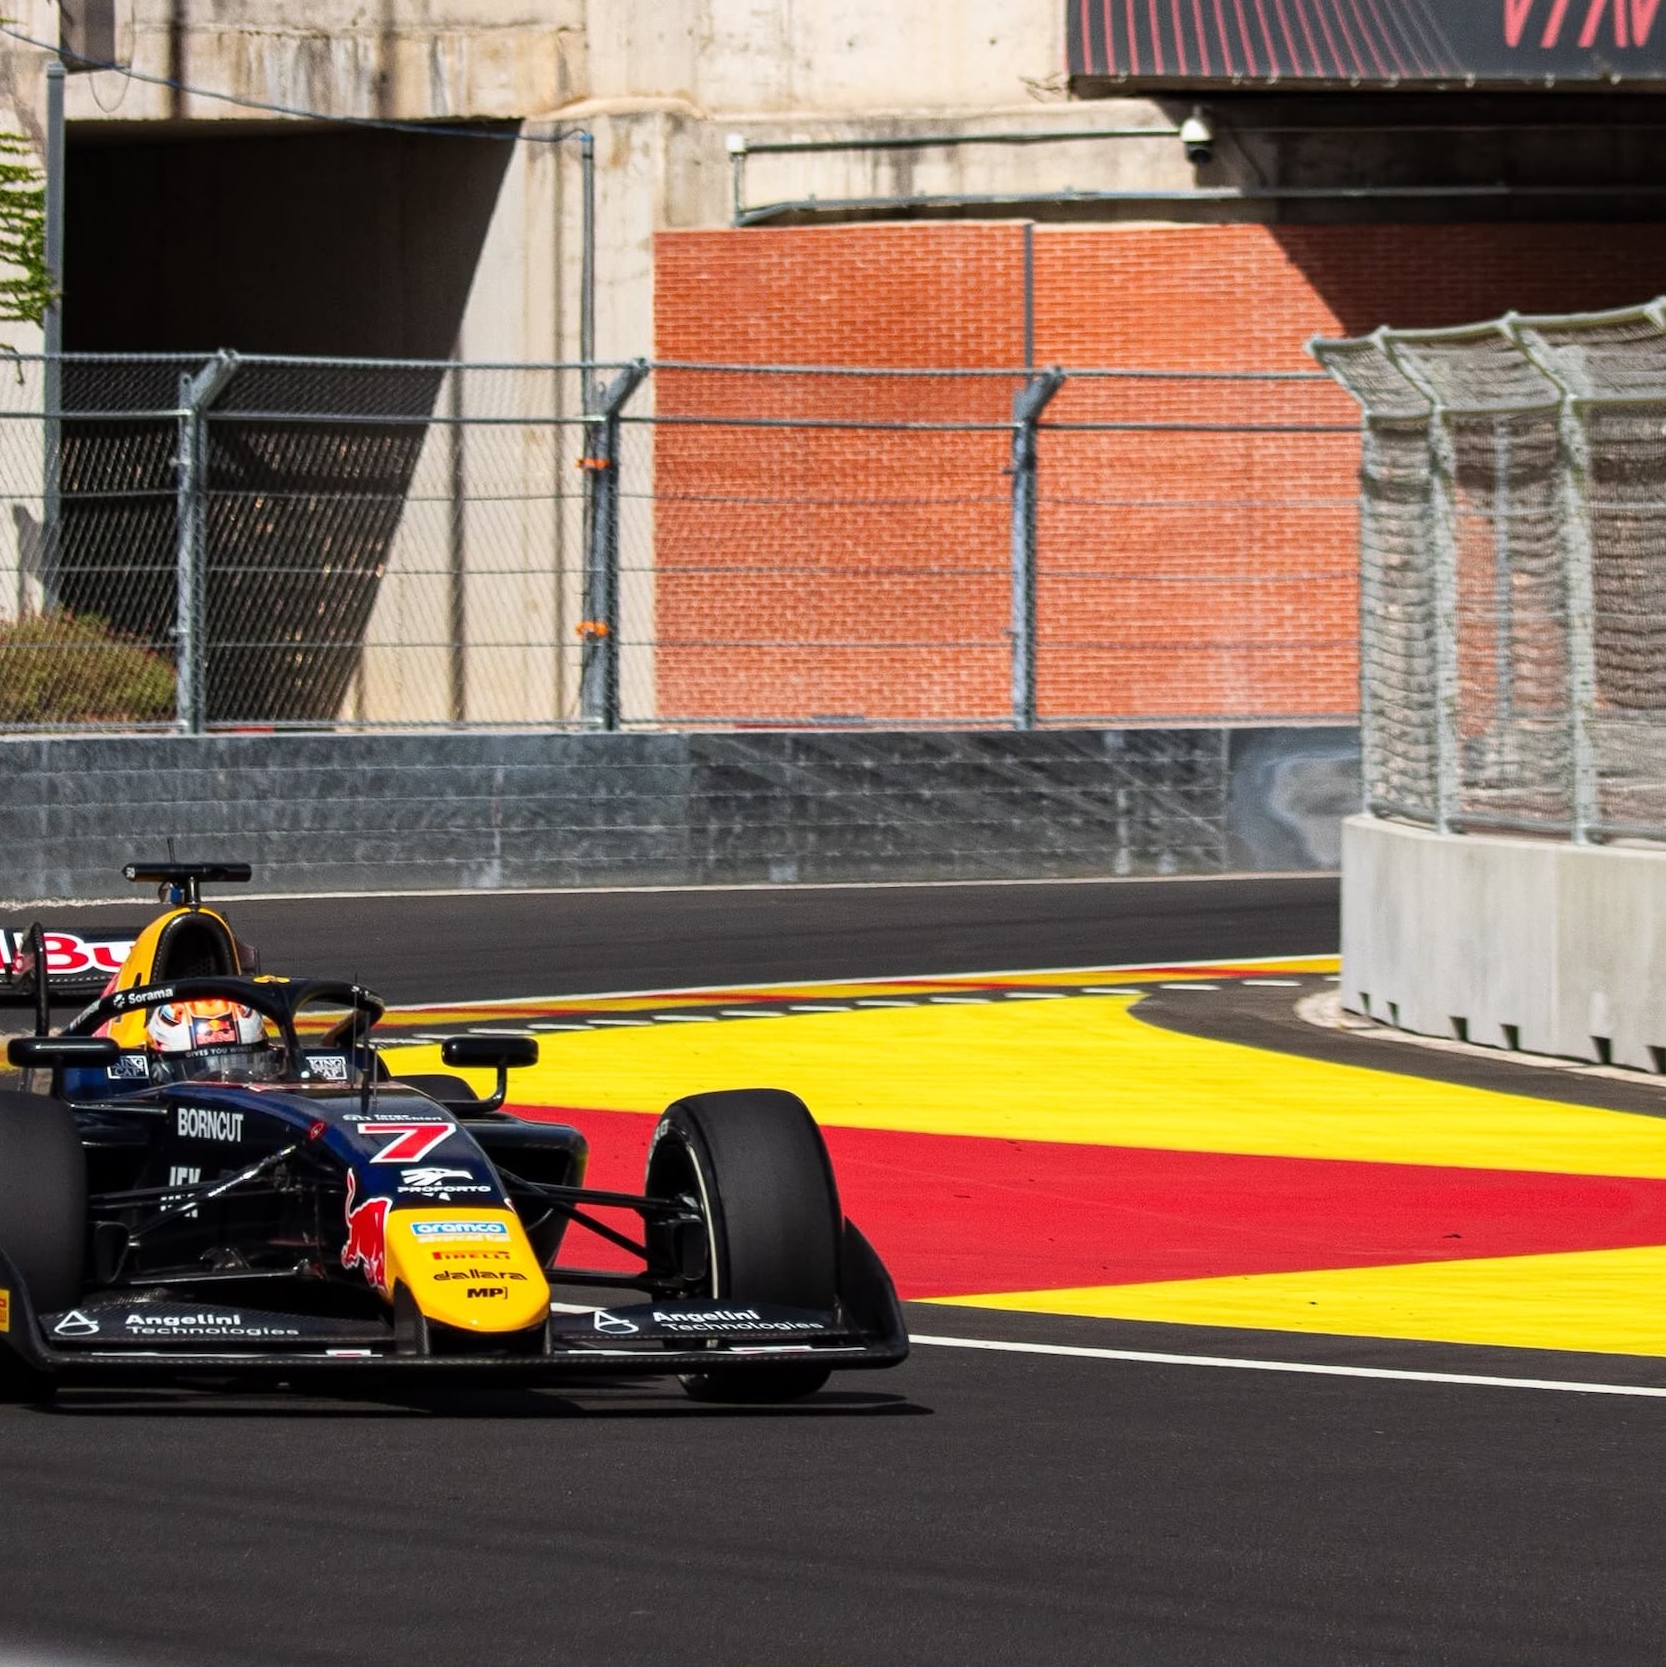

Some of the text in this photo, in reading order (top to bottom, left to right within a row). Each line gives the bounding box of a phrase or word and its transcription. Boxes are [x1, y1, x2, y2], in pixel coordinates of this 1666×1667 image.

[128, 988, 174, 1004] Sorama
[177, 1107, 244, 1142] BORNCUT
[357, 1123, 457, 1163] 7
[417, 1223, 503, 1233] aramco
[432, 1251, 511, 1261] PIRELLI
[433, 1269, 528, 1282] dallara
[125, 1314, 241, 1326] Angelini
[652, 1310, 760, 1322] Angelini
[126, 1326, 300, 1337] Technologies
[661, 1322, 824, 1332] Technologies
